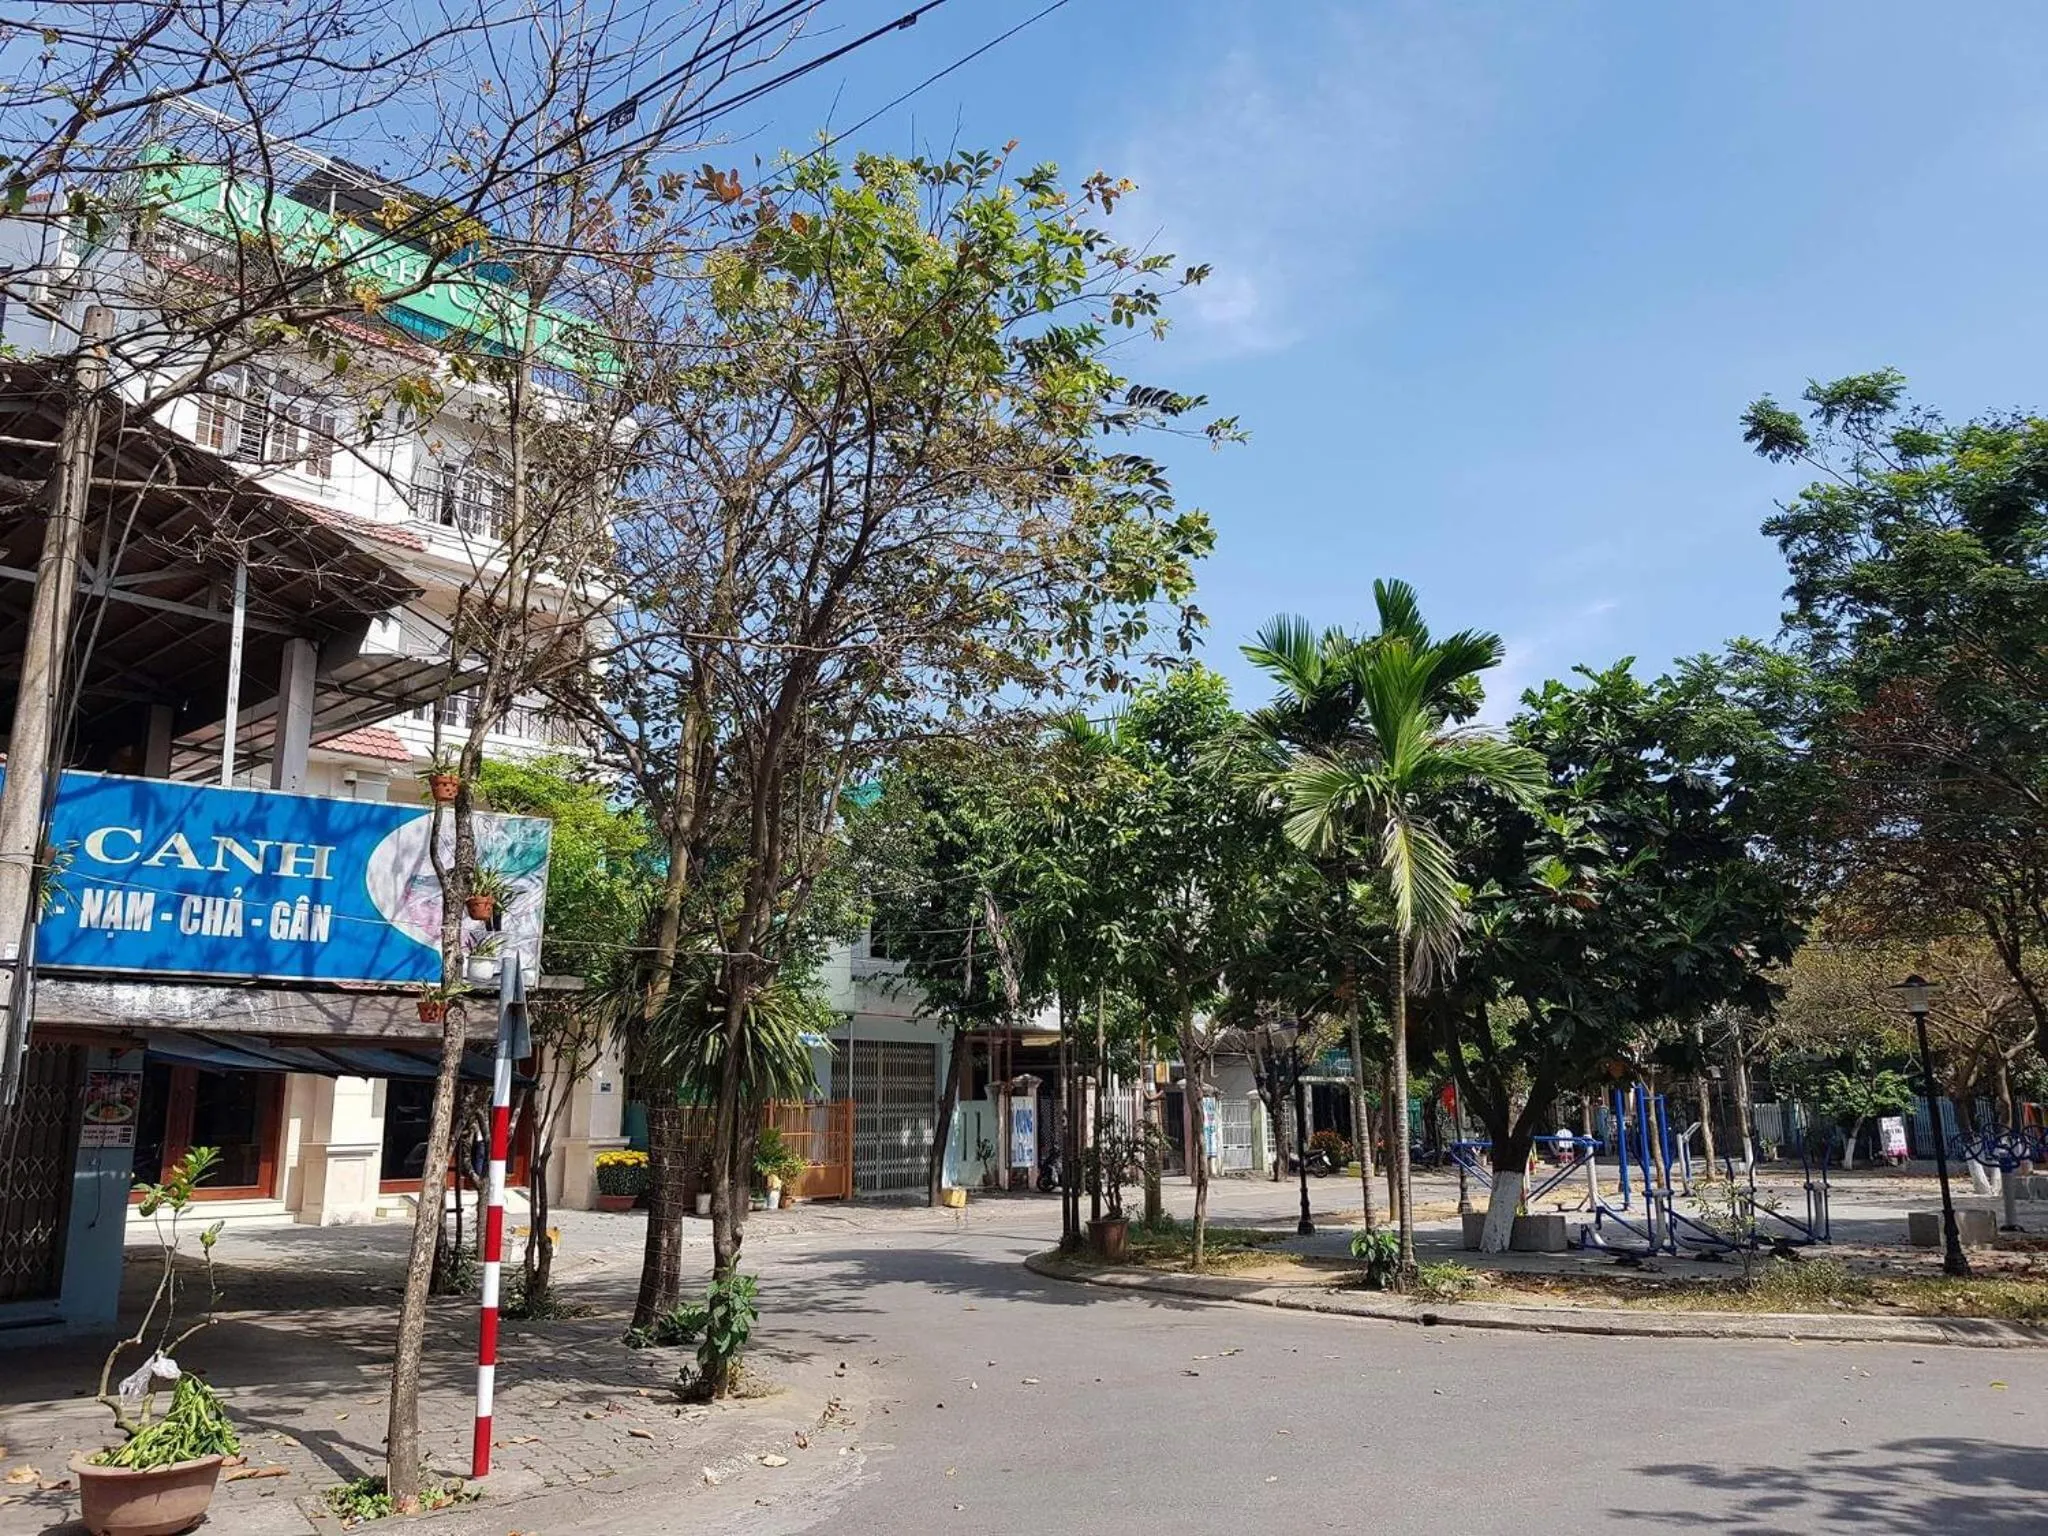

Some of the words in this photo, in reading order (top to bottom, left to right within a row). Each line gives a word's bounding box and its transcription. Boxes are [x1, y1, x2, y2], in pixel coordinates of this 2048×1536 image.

[84, 826, 337, 880] CANH
[79, 888, 155, 938] NẠM
[179, 886, 243, 938] CHẢ
[269, 895, 332, 942] GÂN
